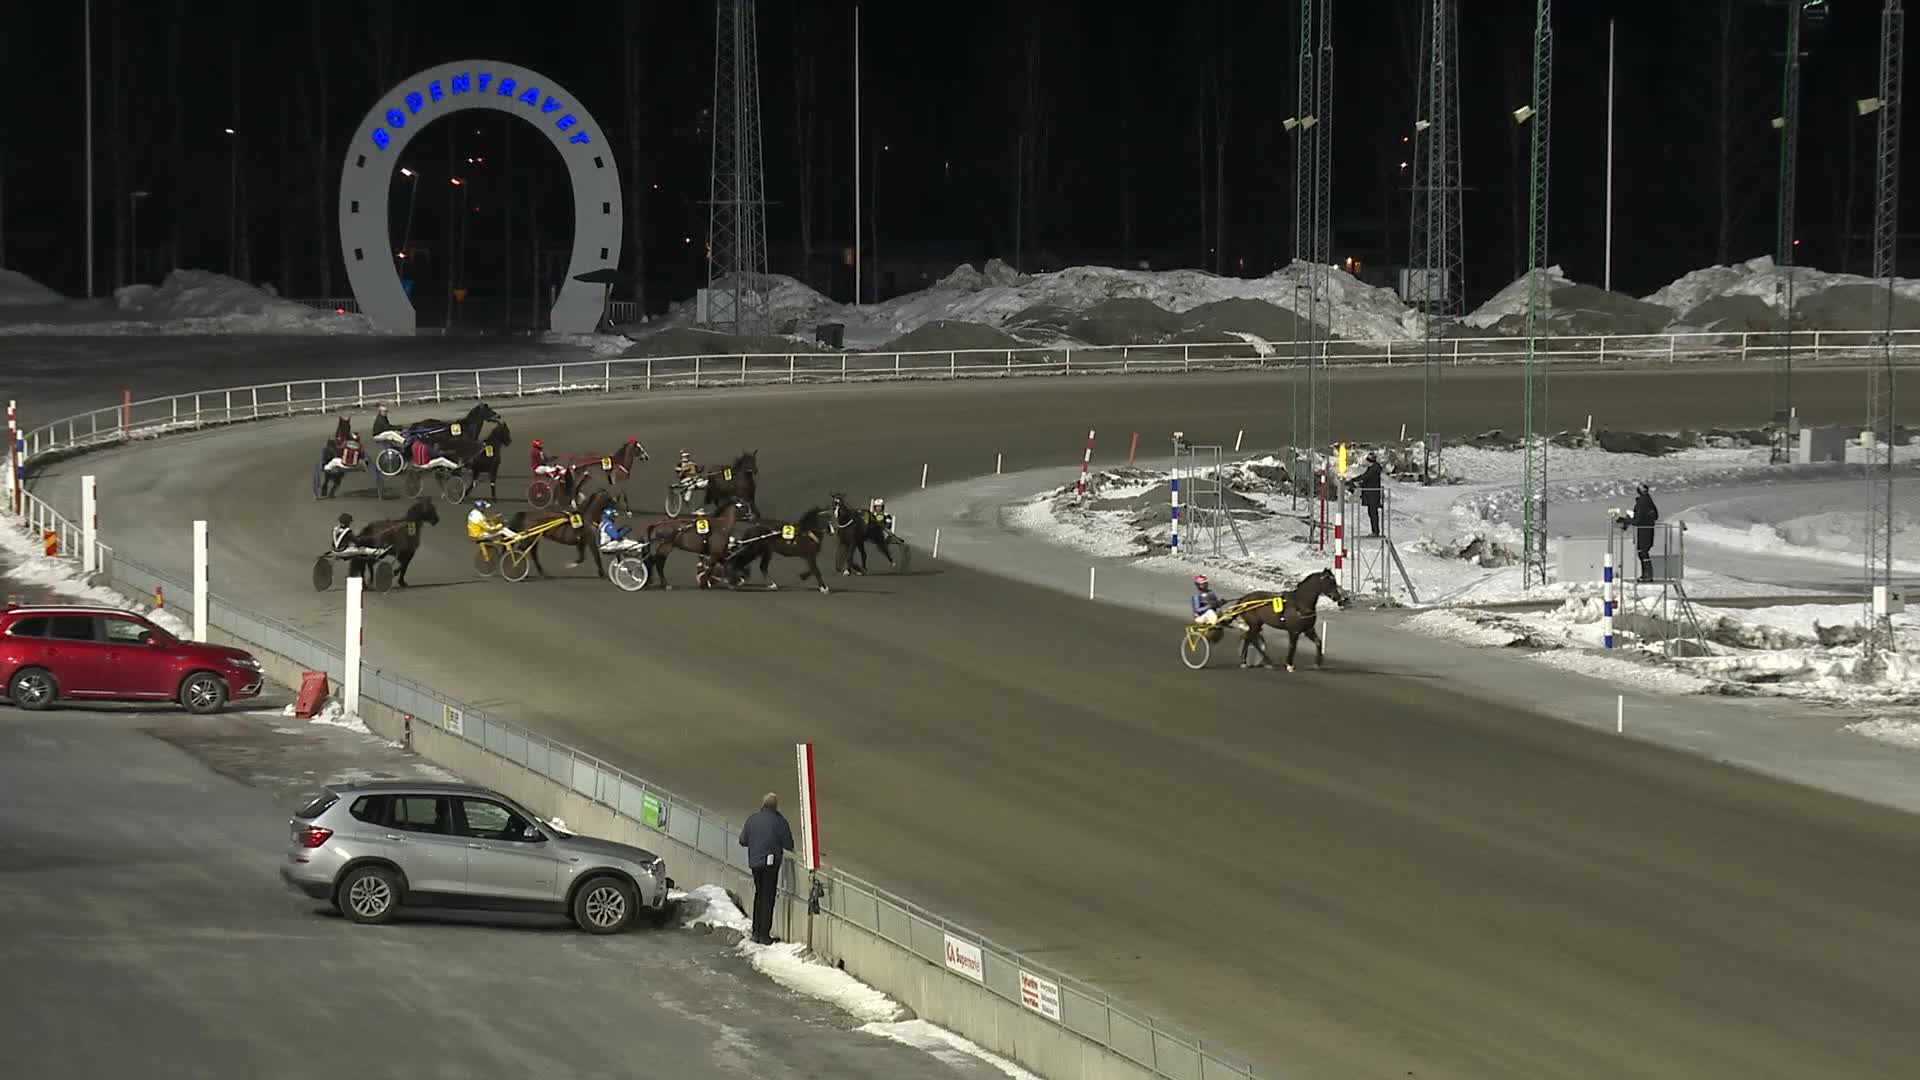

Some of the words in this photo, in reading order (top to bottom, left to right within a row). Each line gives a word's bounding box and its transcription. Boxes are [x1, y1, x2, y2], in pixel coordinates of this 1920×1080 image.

[371, 72, 591, 150] BODENTRAVET
[698, 520, 706, 529] 3
[785, 526, 793, 535] 2
